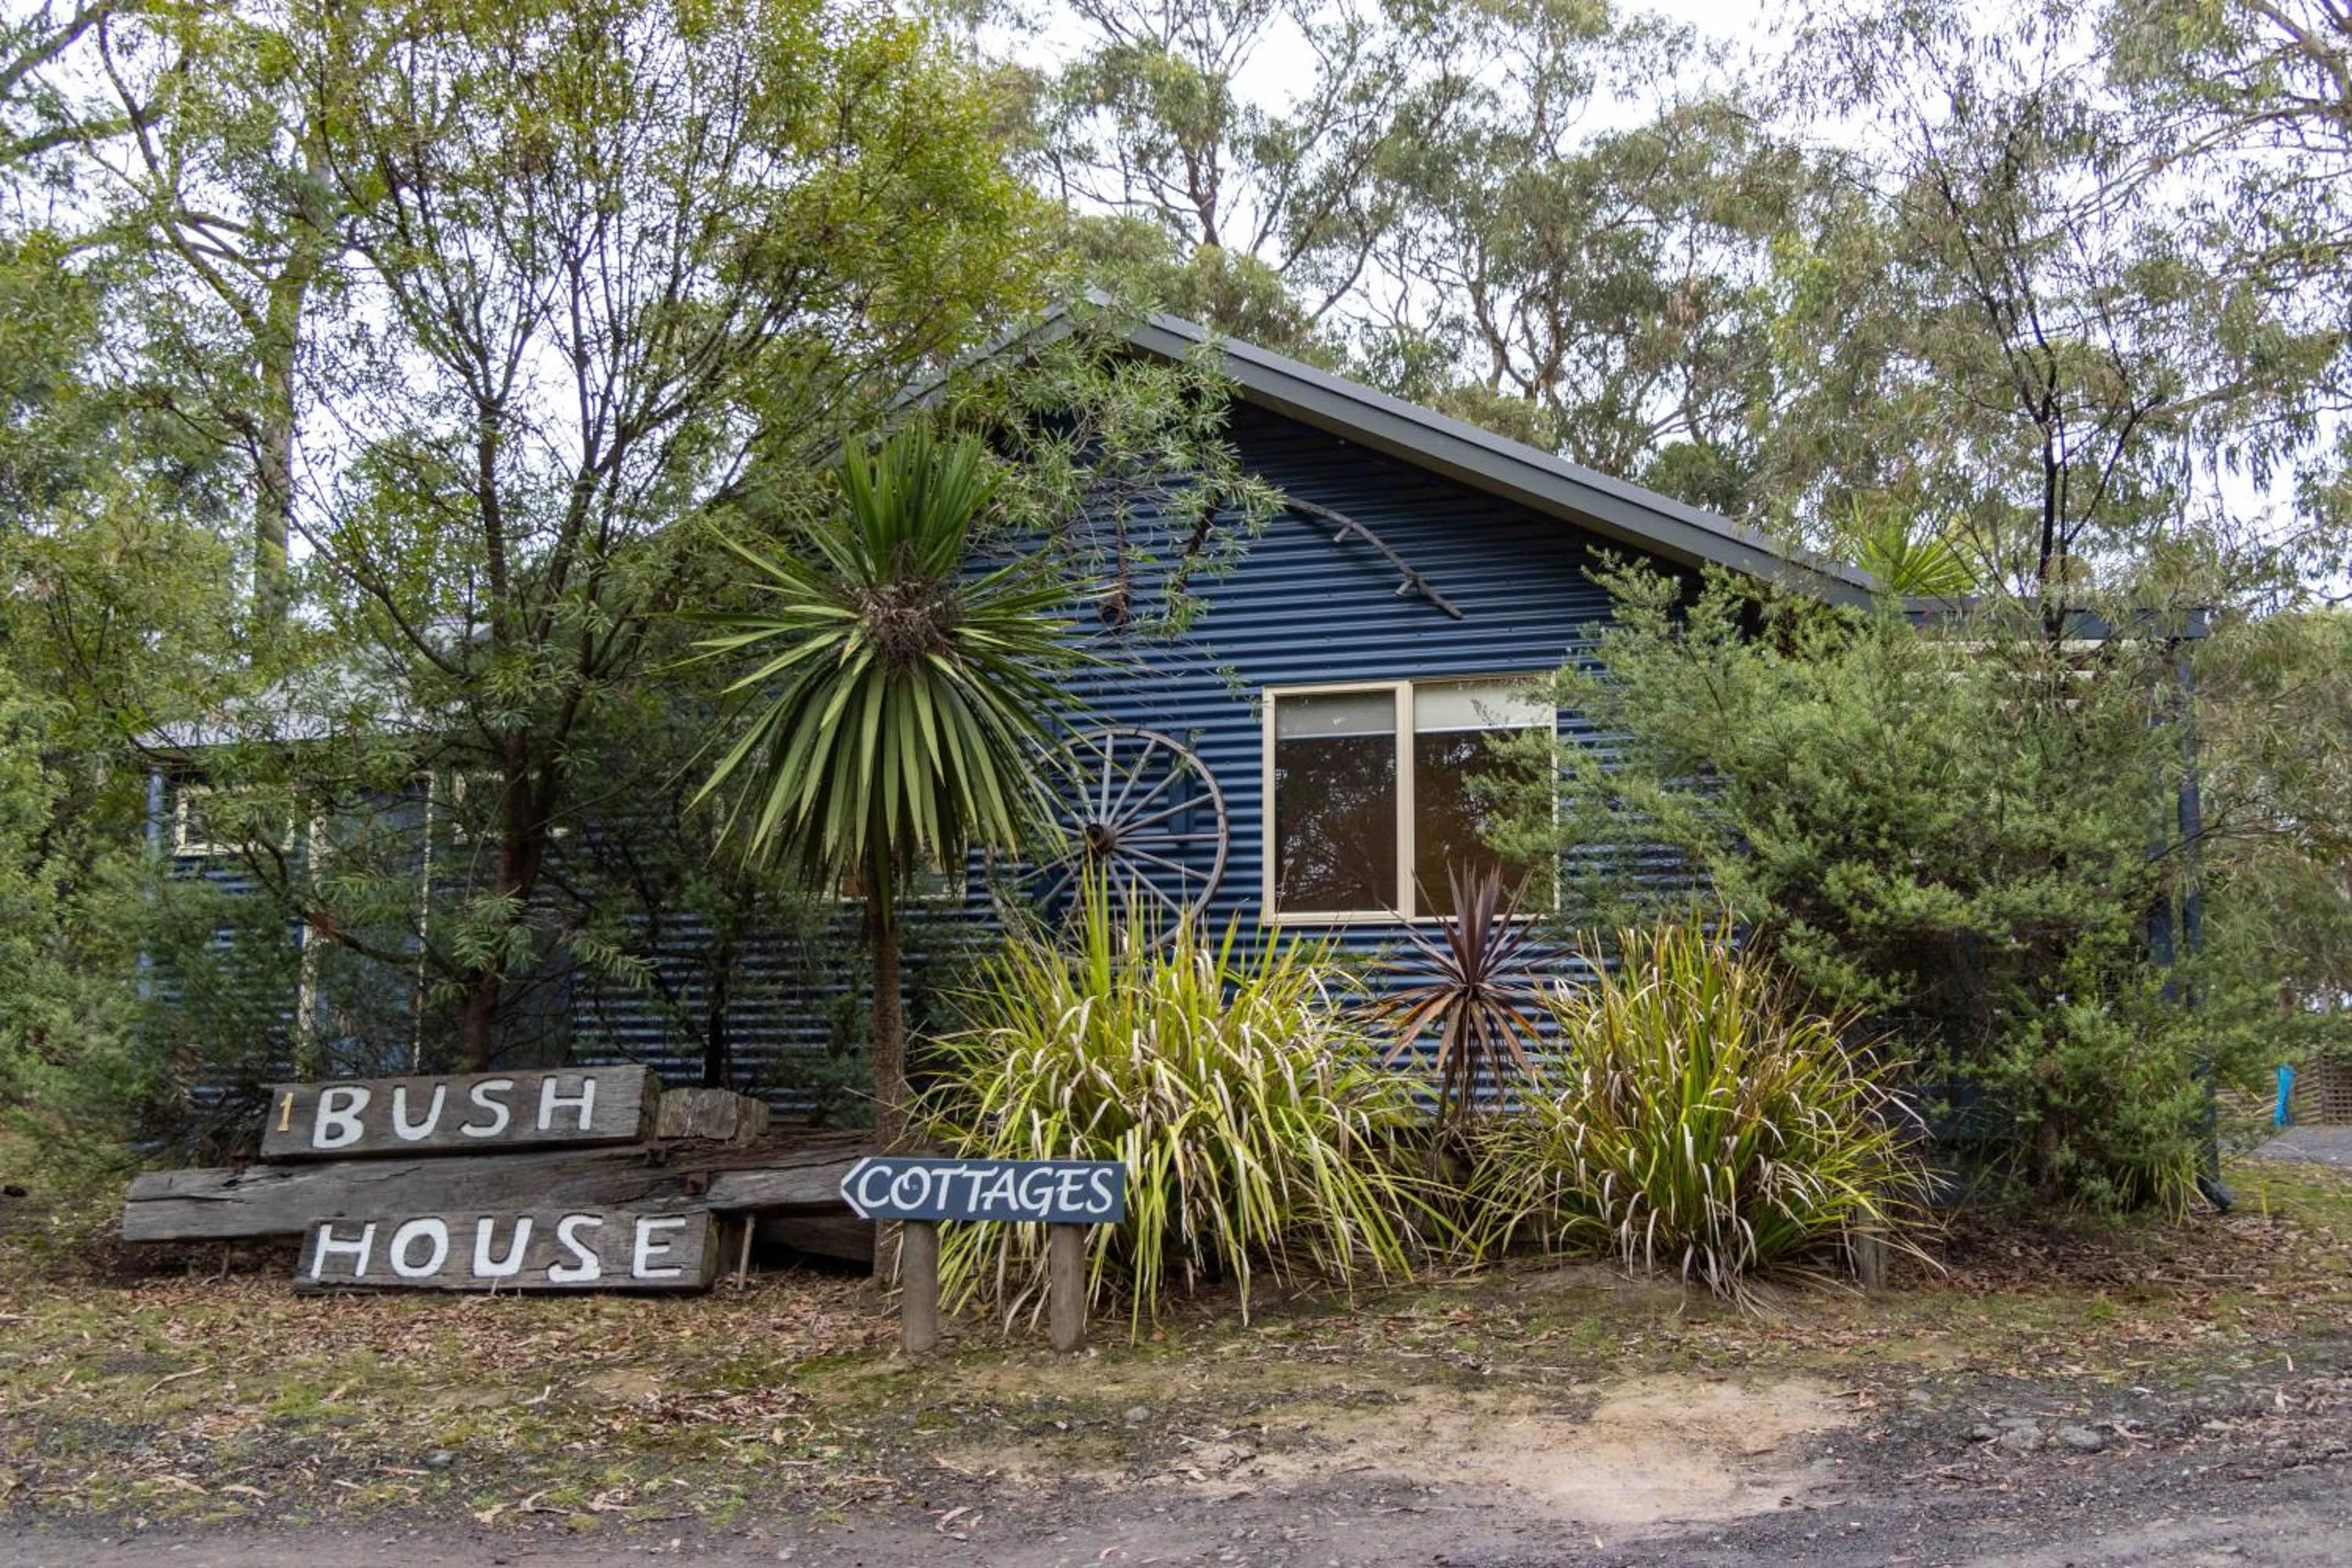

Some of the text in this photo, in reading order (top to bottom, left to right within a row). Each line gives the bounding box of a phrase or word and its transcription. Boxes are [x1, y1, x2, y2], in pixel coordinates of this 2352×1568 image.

[277, 1077, 596, 1149] 1 BUSH
[858, 1163, 1114, 1217] COTTAGES
[311, 1214, 688, 1283] HOUSE
